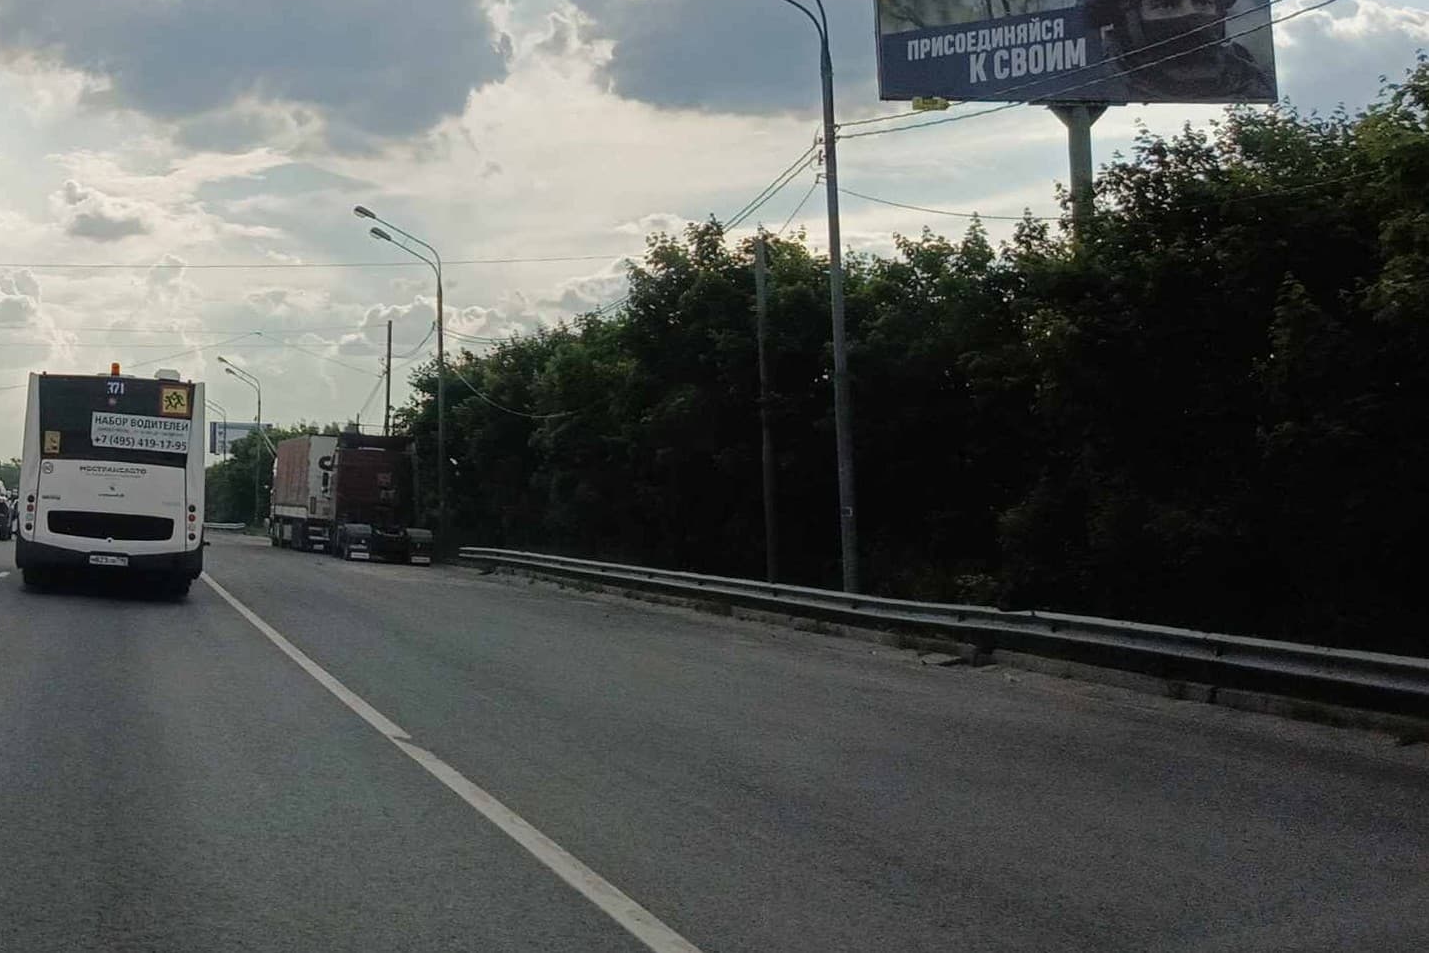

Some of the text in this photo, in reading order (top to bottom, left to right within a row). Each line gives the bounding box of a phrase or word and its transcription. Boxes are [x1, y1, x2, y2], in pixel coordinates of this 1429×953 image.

[907, 17, 1064, 61] ПРИСОЕДИНЯЙСЯ
[970, 38, 1087, 84] К СВОИМ
[94, 415, 129, 427] НАБОР
[130, 418, 189, 432] ВОДИТЕЛЕЙ
[94, 434, 107, 444] +7
[109, 435, 135, 447] (495)
